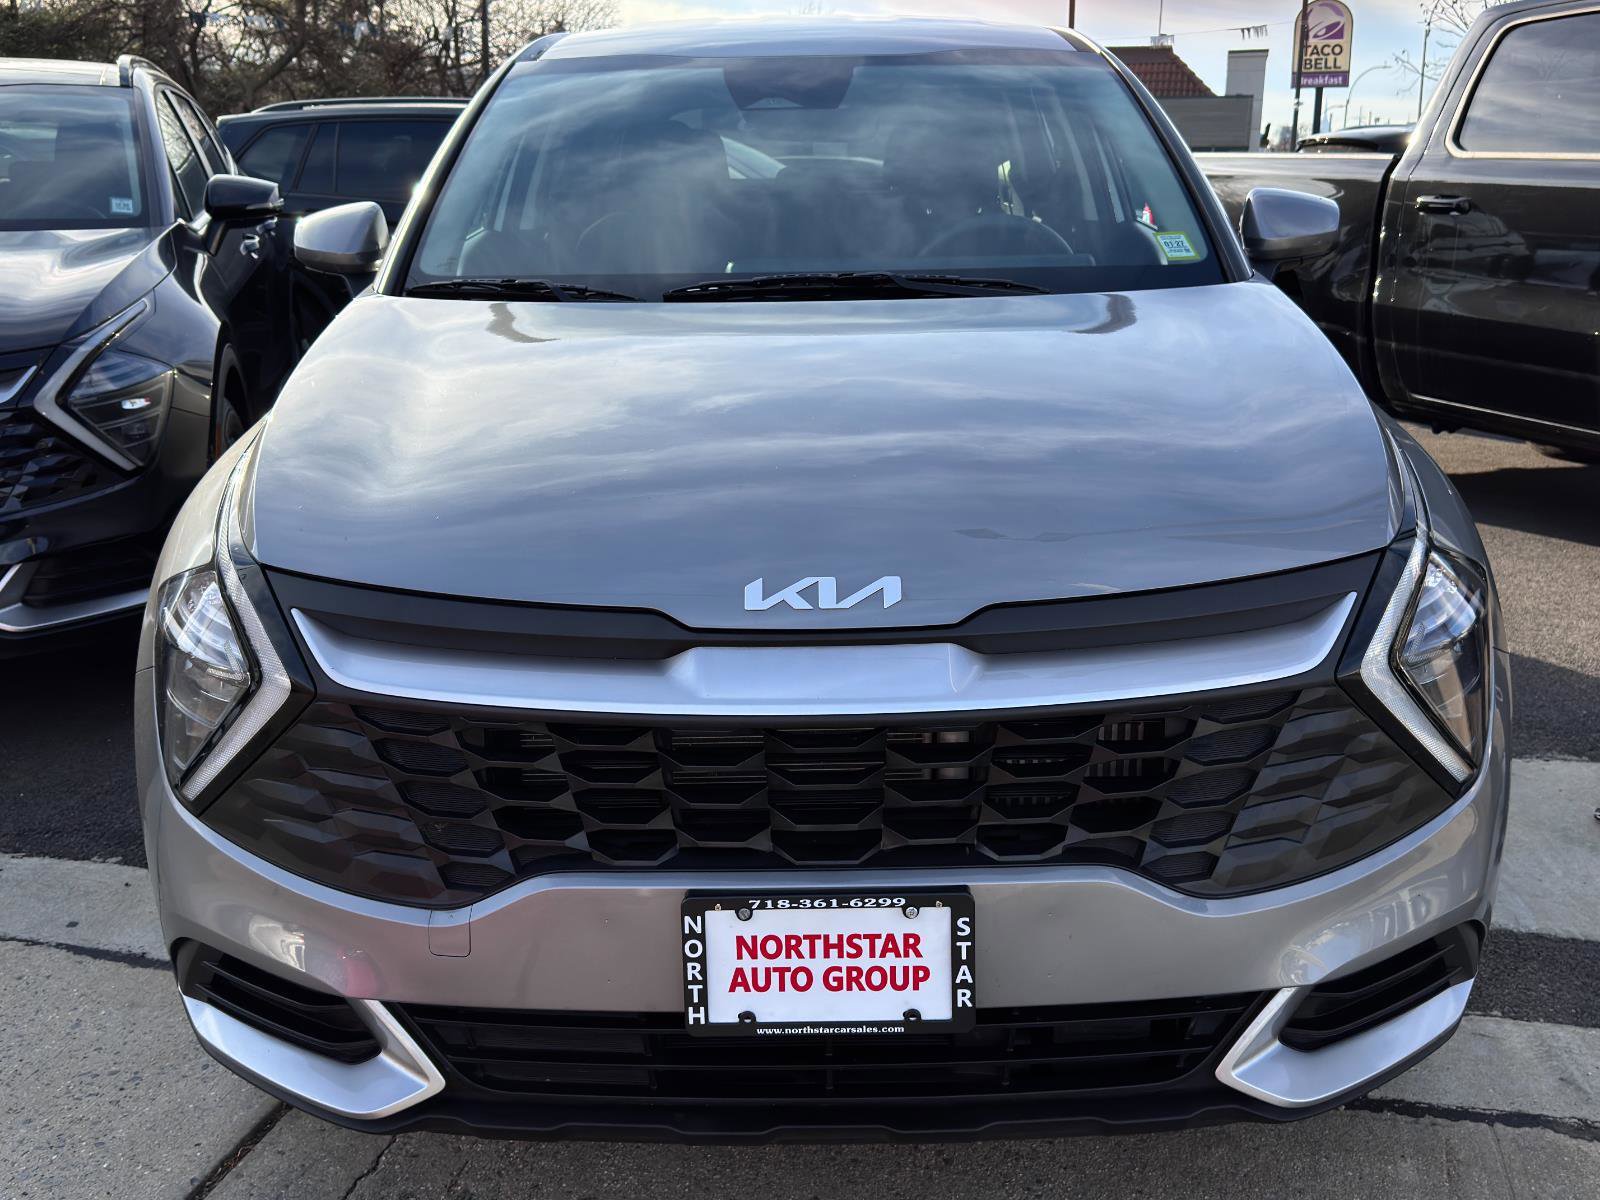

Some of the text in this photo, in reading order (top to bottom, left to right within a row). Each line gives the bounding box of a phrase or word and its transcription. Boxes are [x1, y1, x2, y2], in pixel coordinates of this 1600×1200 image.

[1303, 44, 1343, 57] TACO
[1303, 57, 1341, 70] BELL
[1300, 75, 1343, 86] reakfast
[744, 576, 901, 611] KIA
[749, 897, 906, 909] 718-361-6299
[735, 933, 923, 960] NORTHSTAR
[684, 915, 706, 1025] NORTH
[955, 917, 973, 1008] STAR
[728, 966, 930, 993] AUTO GROUP
[756, 1025, 905, 1035] www.northstarcarsales.com
